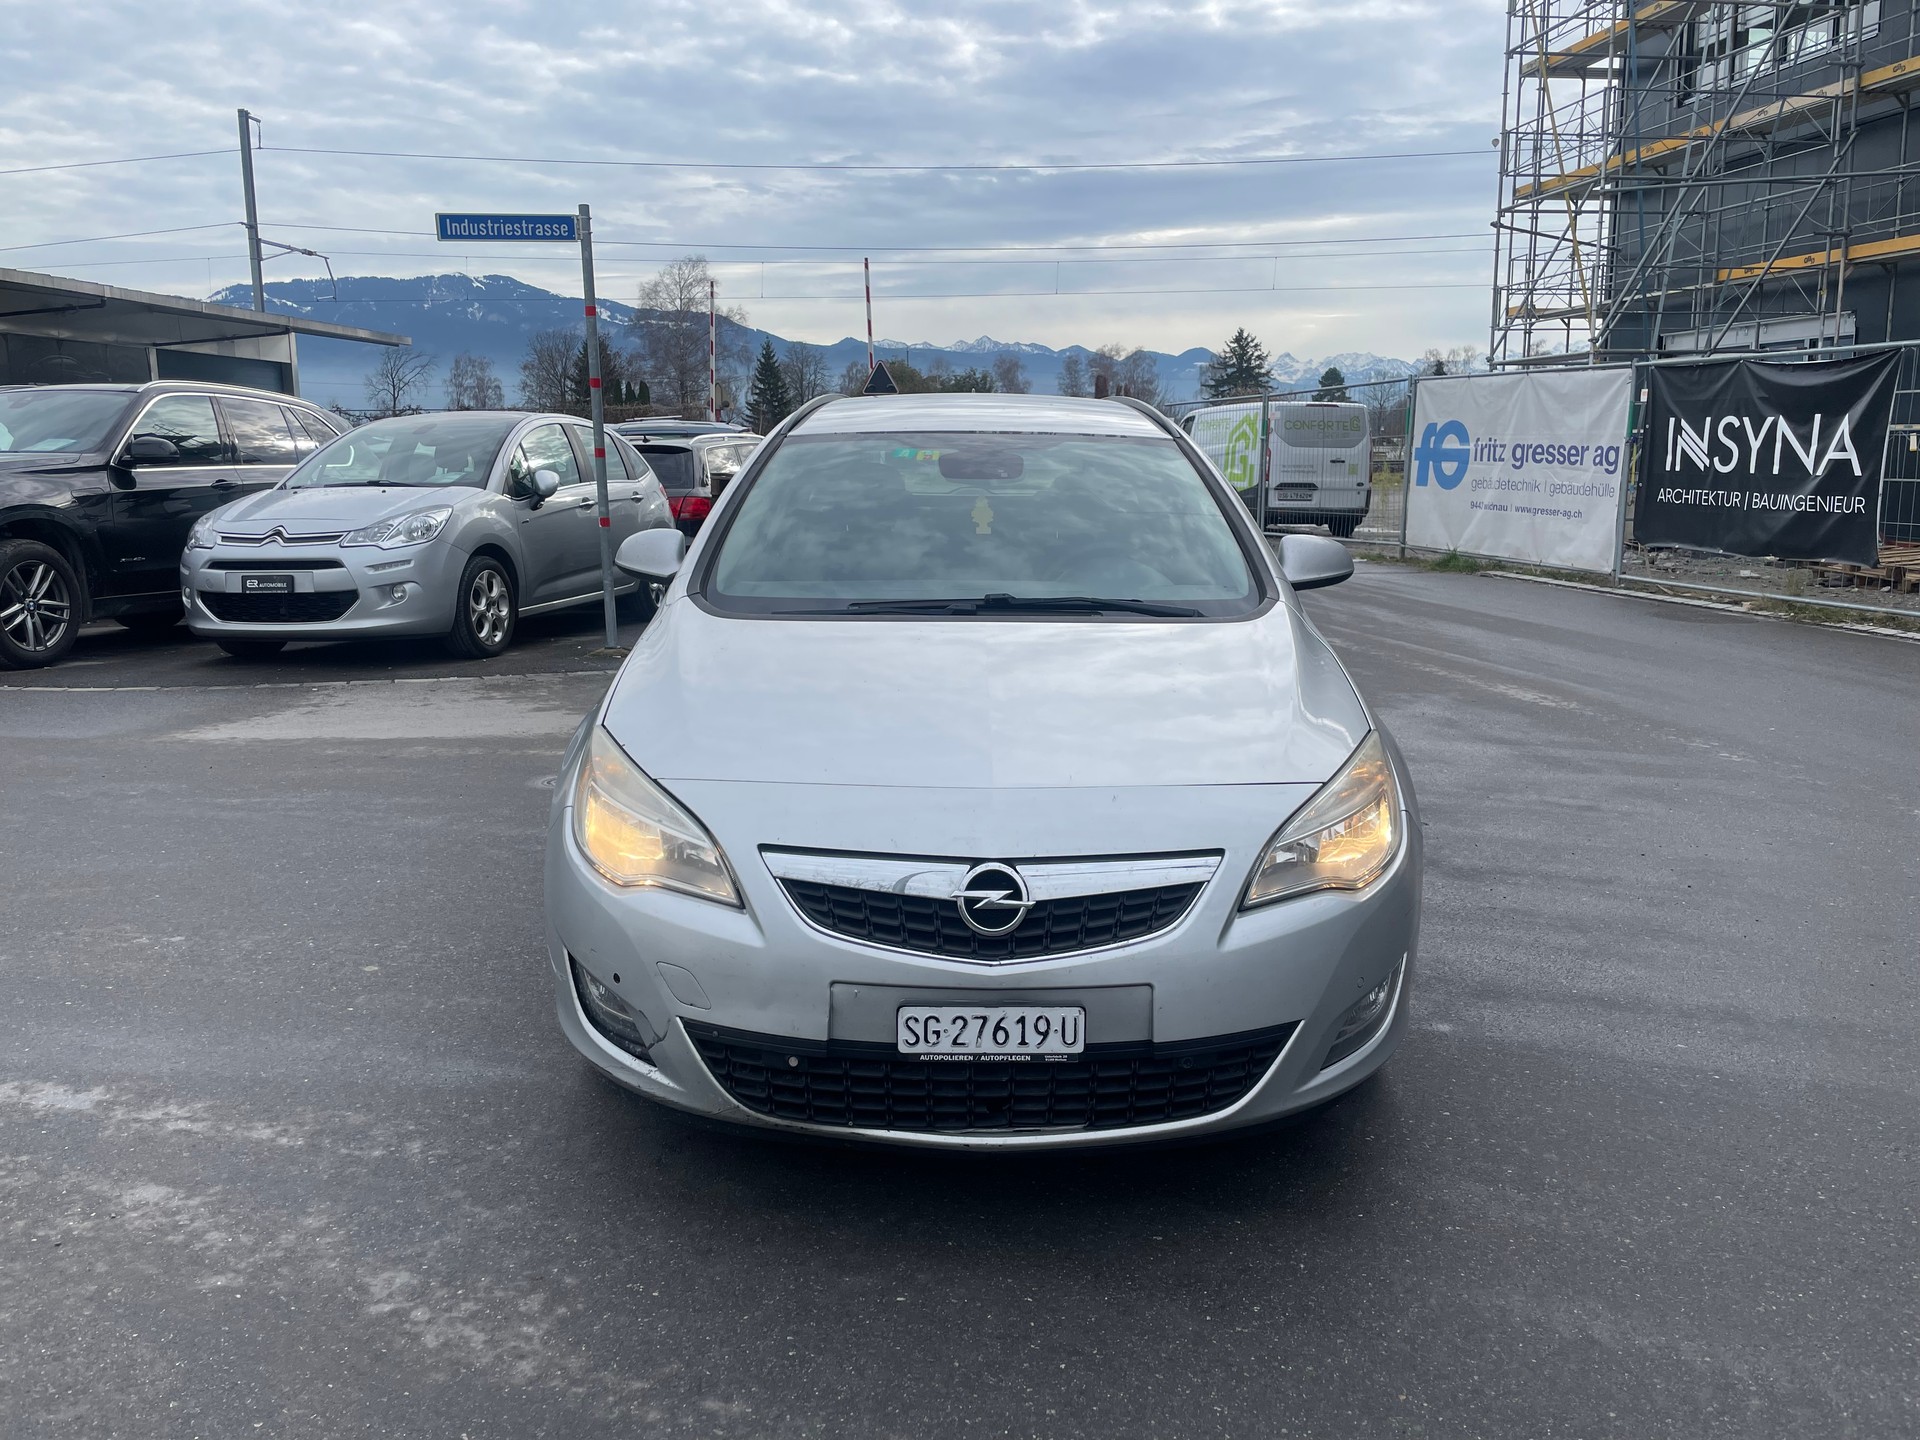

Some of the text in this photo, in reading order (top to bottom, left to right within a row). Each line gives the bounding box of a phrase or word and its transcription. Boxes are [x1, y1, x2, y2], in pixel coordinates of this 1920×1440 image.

[446, 219, 569, 236] Industriestrasse
[1665, 413, 1863, 477] INSYNA
[1473, 437, 1620, 475] fritz gresser ag
[1549, 481, 1615, 498] gebäudehülle
[1657, 488, 1742, 508] ARCHITEKTUR
[1751, 493, 1866, 514] BAUINGENIEUR
[1514, 505, 1583, 520] www.gresser-ag.ch
